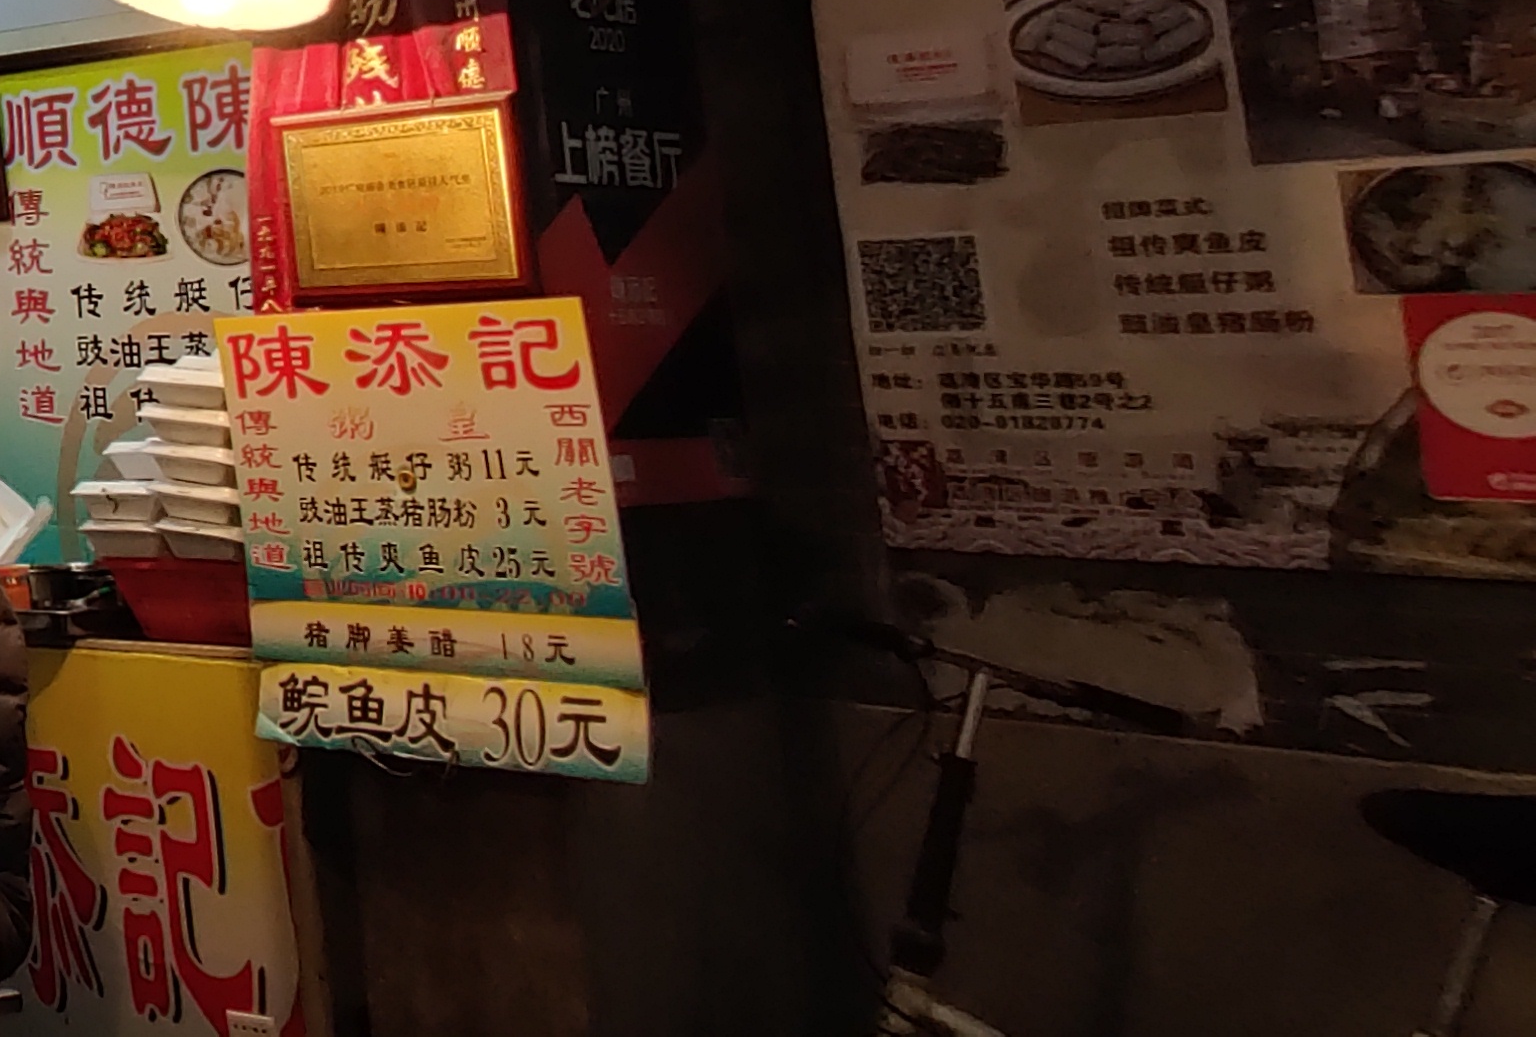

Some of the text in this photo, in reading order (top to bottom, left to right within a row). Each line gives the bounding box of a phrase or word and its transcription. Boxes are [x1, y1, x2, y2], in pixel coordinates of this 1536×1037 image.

[554, 121, 683, 190] 上榜餐厅
[7, 189, 66, 425] 傳統與地道
[226, 316, 583, 401] 陳添記
[235, 409, 298, 571] 傳統與地道
[542, 402, 622, 587] 西關老字號
[277, 672, 460, 755] 鲩鱼皮
